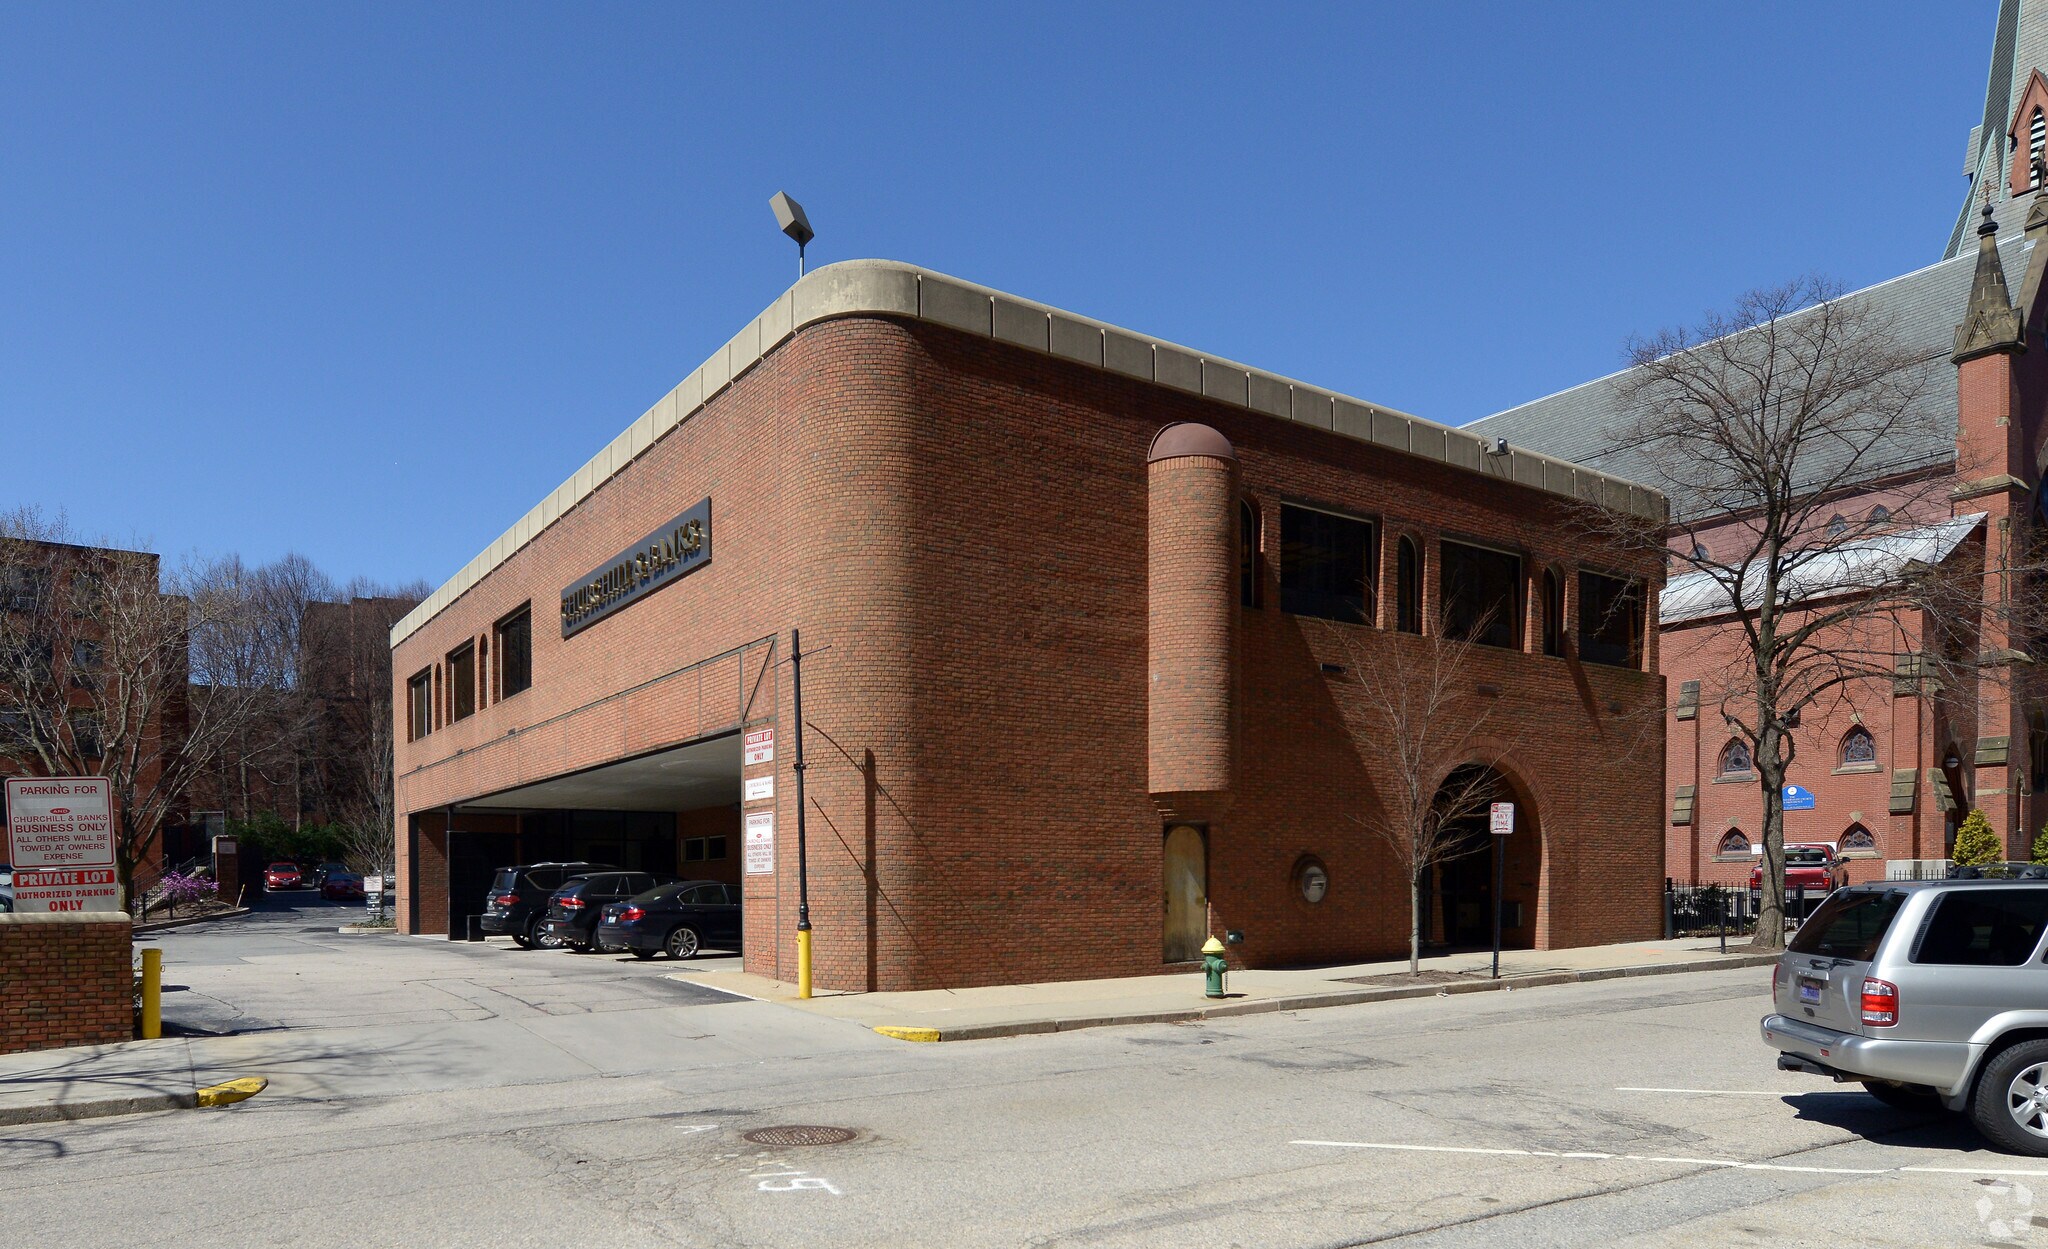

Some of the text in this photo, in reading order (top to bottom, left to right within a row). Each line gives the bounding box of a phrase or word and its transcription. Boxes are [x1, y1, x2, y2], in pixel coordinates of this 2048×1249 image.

[649, 518, 704, 572] BANKS
[20, 785, 97, 795] PARKING FOR
[13, 815, 66, 823] CHURCHILL
[15, 823, 107, 833] BUSINESS ONLY
[44, 852, 83, 860] EXPENSE
[20, 871, 109, 886] PRIVATE LOT
[16, 889, 115, 900] AUTHORIZED PARKING
[48, 900, 84, 912] ONLY
